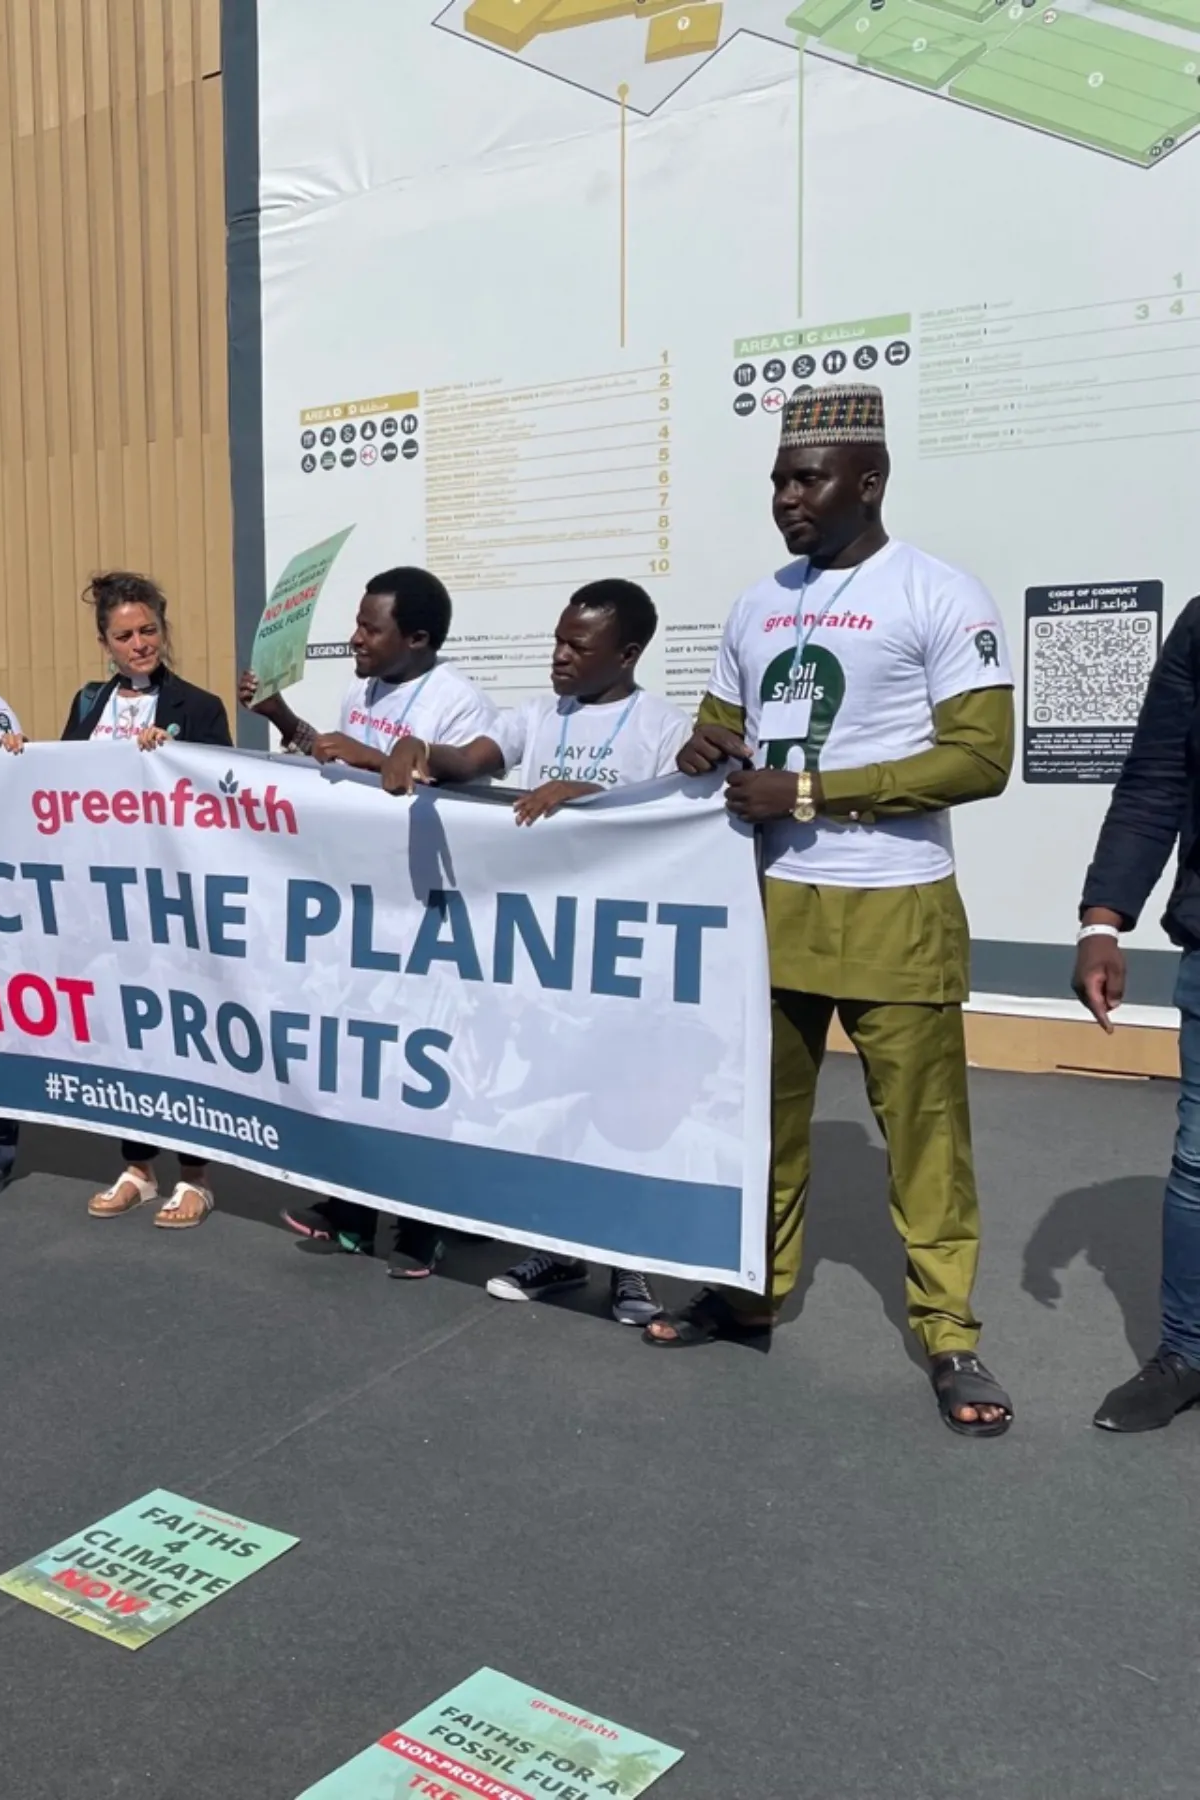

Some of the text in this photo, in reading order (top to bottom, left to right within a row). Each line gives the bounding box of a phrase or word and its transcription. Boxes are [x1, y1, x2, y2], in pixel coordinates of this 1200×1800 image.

[1172, 272, 1182, 289] 1
[1134, 299, 1183, 320] 3 4
[739, 334, 795, 354] AREA C
[806, 331, 818, 344] C
[661, 350, 668, 364] 1
[659, 372, 670, 387] 2
[658, 397, 669, 411] 3
[305, 406, 342, 421] AREA D
[658, 424, 668, 439] 4
[658, 447, 669, 461] 5
[658, 470, 668, 484] 6
[658, 492, 668, 506] 7
[658, 515, 669, 528] 8
[658, 536, 668, 550] 9
[649, 558, 669, 572] 10
[1048, 586, 1138, 598] CODE OF CONDUCT
[263, 584, 320, 622] NO MORE
[1048, 597, 1137, 613] قواعد السلوك
[286, 603, 312, 628] FUELS
[308, 646, 345, 656] LEGEND
[789, 662, 817, 680] Oil
[588, 746, 613, 760] UP
[540, 765, 620, 784] FOR LOSS
[32, 774, 298, 835] greenfaith
[90, 865, 248, 958] THE
[285, 878, 728, 1004] PLANET
[120, 984, 454, 1110] PROFITS
[46, 1072, 280, 1149] #Faiths4climate
[139, 1507, 261, 1558] FAITHS
[163, 1540, 190, 1553] 4
[83, 1529, 232, 1594] CLIMATE
[52, 1547, 199, 1609] JUSTICE
[50, 1568, 152, 1616] NOW
[530, 1698, 619, 1741] greenfaith
[428, 1725, 521, 1775] FOSSIL
[440, 1706, 621, 1795] FAITHS FOR A
